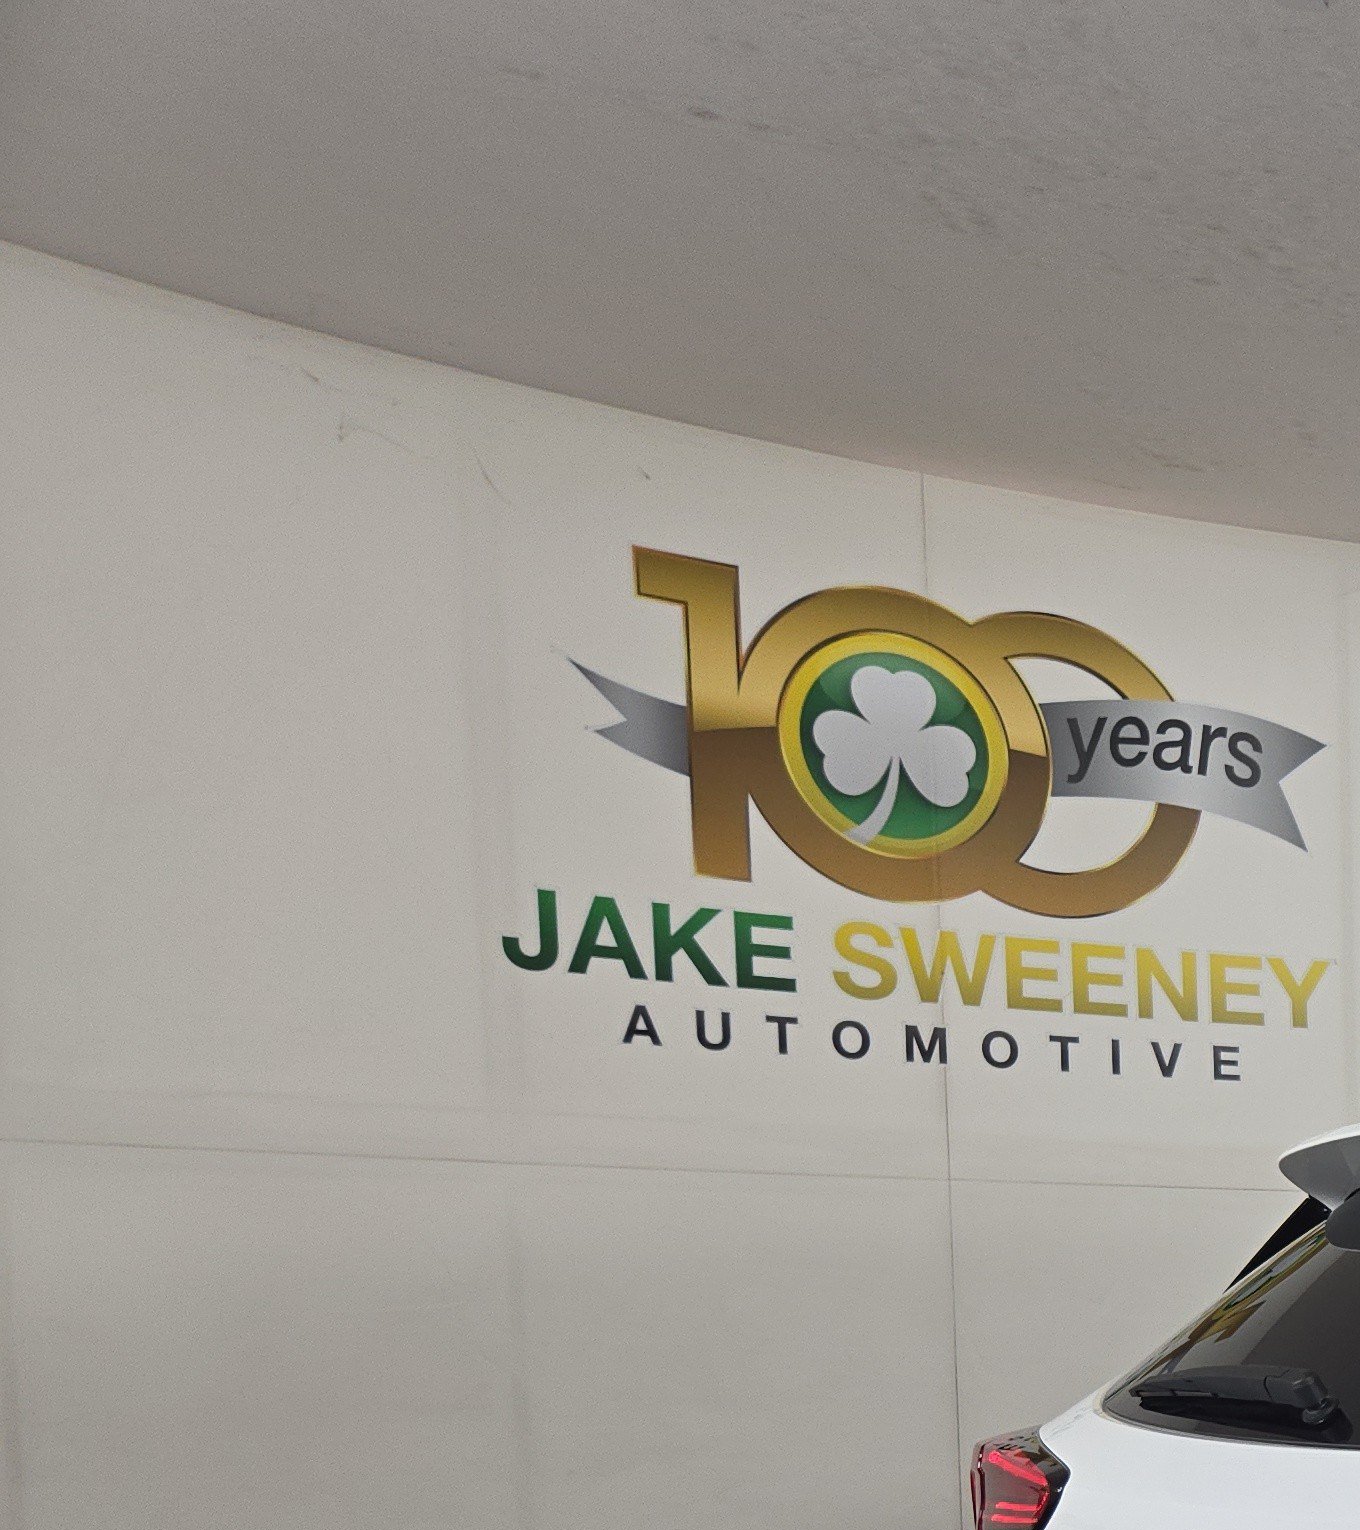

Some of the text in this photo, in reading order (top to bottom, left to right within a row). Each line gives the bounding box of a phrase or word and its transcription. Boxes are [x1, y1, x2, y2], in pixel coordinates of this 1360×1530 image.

[633, 545, 1265, 920] 100 years
[501, 887, 1330, 1030] JAKE SWEENEY
[622, 1004, 1242, 1082] AUTOMOTIVE
